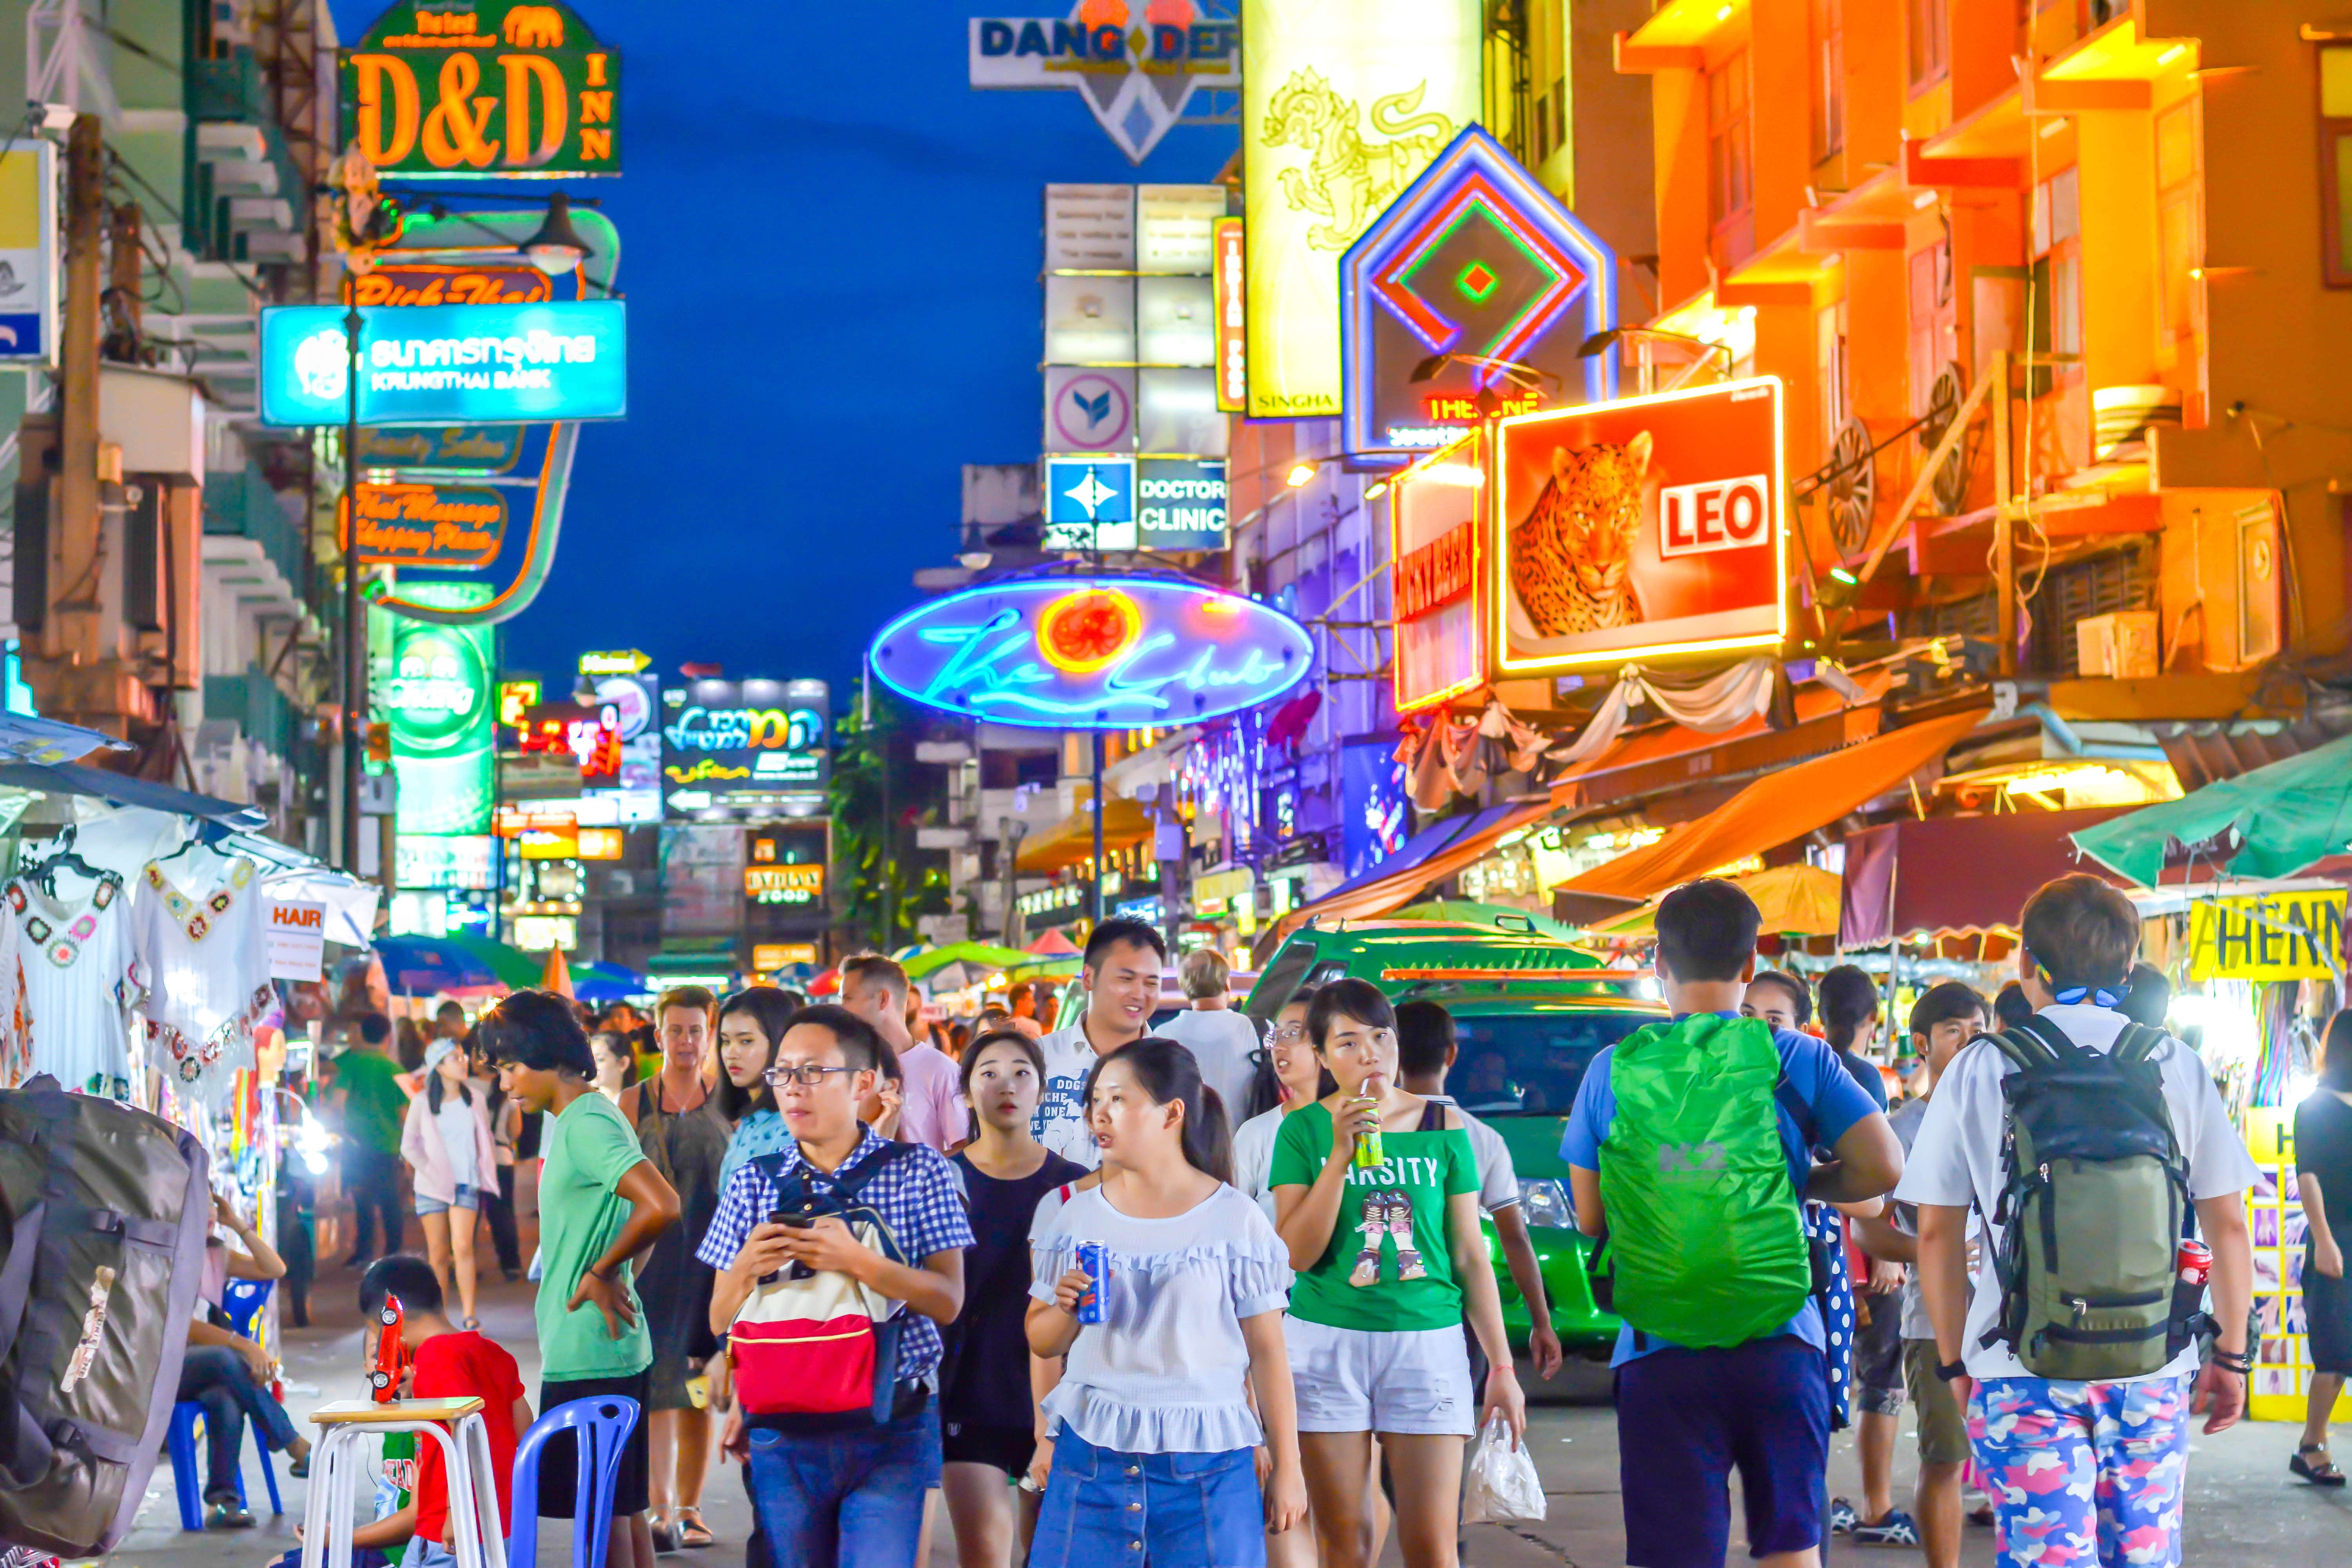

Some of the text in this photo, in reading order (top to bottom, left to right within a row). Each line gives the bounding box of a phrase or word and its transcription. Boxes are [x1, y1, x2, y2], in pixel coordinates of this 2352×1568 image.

[981, 20, 1126, 59] DANG
[351, 52, 568, 168] D&D
[579, 53, 613, 160] INN
[371, 369, 551, 391] KRUNGTHAI BANK
[1258, 394, 1333, 408] SINGHA
[1490, 392, 1539, 417] NE
[1139, 479, 1226, 499] DOCTOR
[1139, 507, 1226, 532] CLINIC
[1668, 485, 1762, 547] LEO
[917, 608, 1285, 698] The Club
[389, 679, 475, 715] Chang
[746, 870, 820, 889] INDIAN
[273, 906, 321, 929] HAIR
[1321, 1157, 1437, 1187] ARSITY
